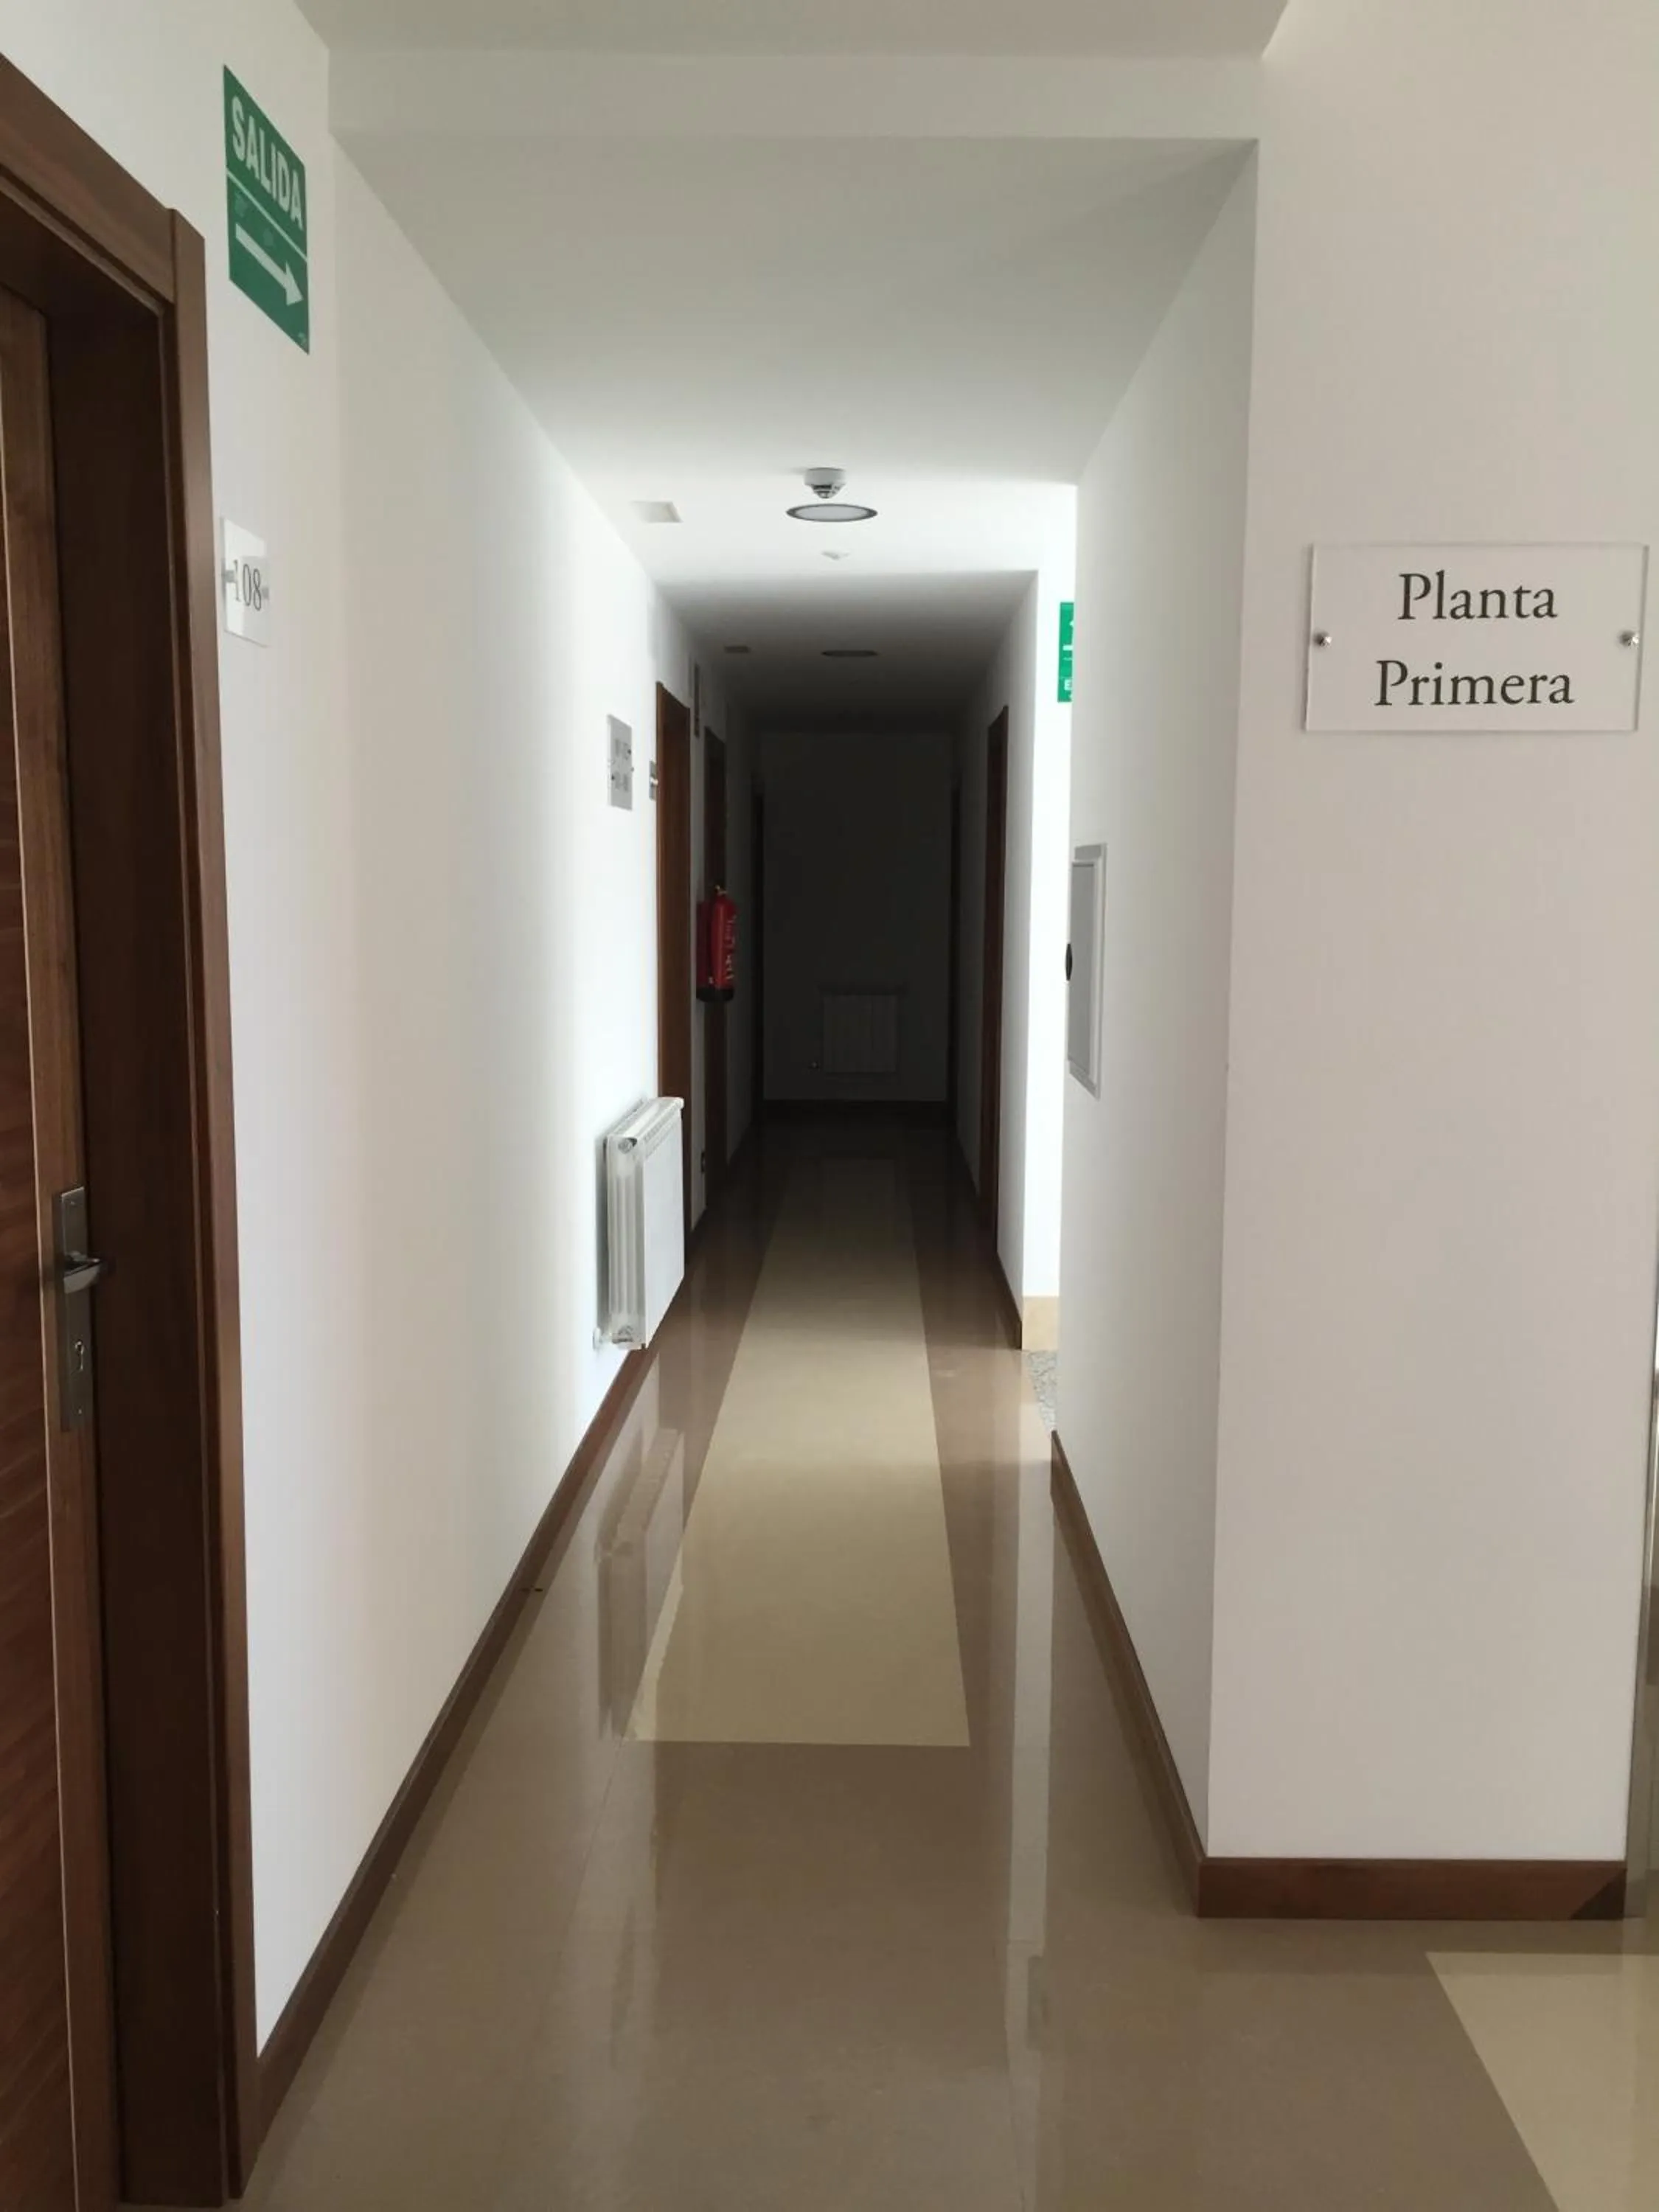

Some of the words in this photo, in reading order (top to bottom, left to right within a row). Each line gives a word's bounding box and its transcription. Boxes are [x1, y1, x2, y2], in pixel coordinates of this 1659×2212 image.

[232, 96, 303, 231] SALIDA
[233, 560, 262, 611] 108
[1397, 570, 1558, 620] Planta
[1374, 659, 1575, 706] Primera
